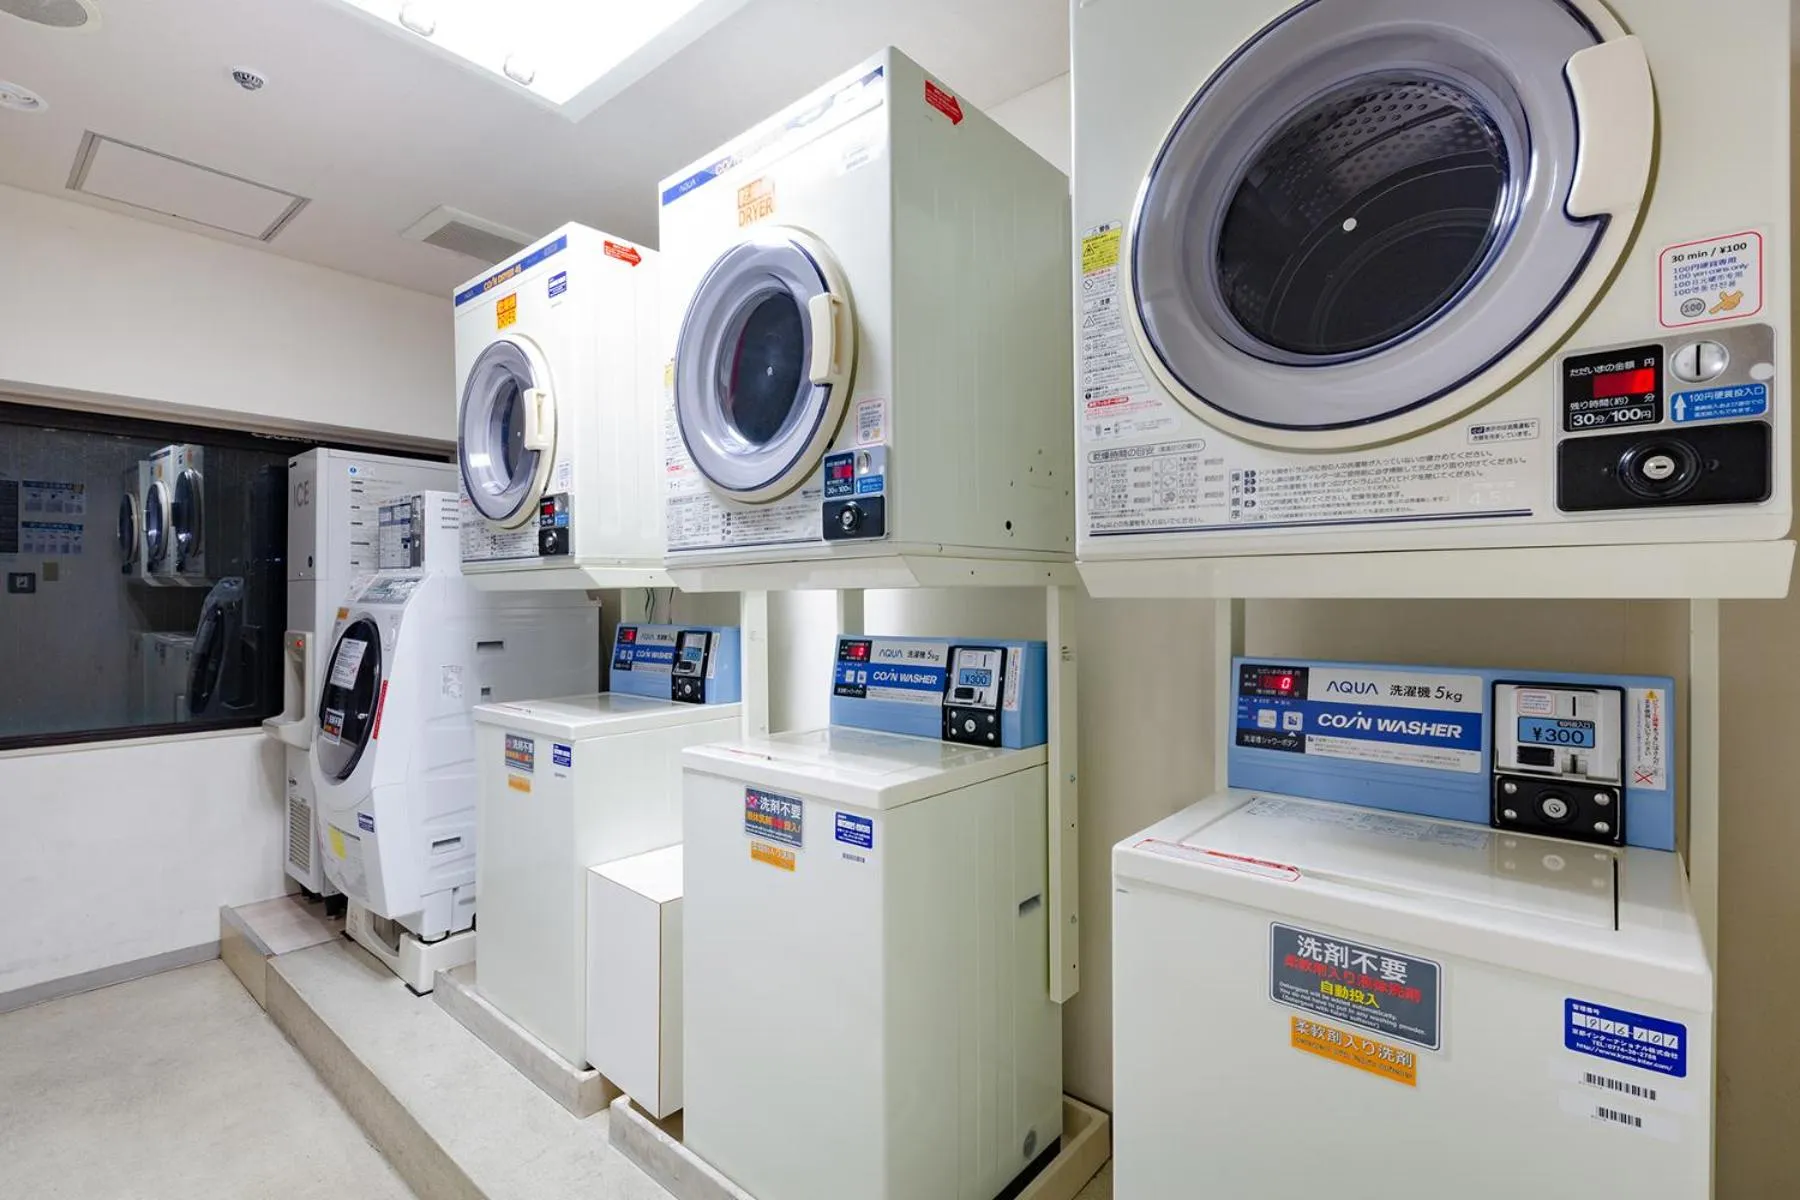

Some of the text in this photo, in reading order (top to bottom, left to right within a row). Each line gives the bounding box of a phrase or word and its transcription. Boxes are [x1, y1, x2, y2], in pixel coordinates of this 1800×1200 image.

[738, 197, 774, 227] DRYER
[1671, 254, 1685, 264] 30
[1687, 250, 1708, 261] min
[1719, 242, 1748, 254] ¥100
[1684, 302, 1702, 314] 100
[1569, 357, 1656, 377] ただいまの金額 円
[1643, 393, 1656, 403] 分
[1689, 386, 1765, 403] 100円硬貨投入口
[293, 480, 310, 508] ICE
[879, 648, 903, 659] AQUA
[900, 672, 938, 685] WASHER
[1281, 677, 1292, 690] 0
[1326, 680, 1463, 703] AQUA 洗濯機 5kg
[1376, 718, 1463, 739] WASHER
[1532, 726, 1585, 745] ¥300
[760, 796, 802, 820] 洗剤不要
[1297, 934, 1408, 985] 洗剤不要
[1320, 980, 1380, 1009] 自動投入
[1295, 1020, 1414, 1070] 柔軟剤入り洗剤
